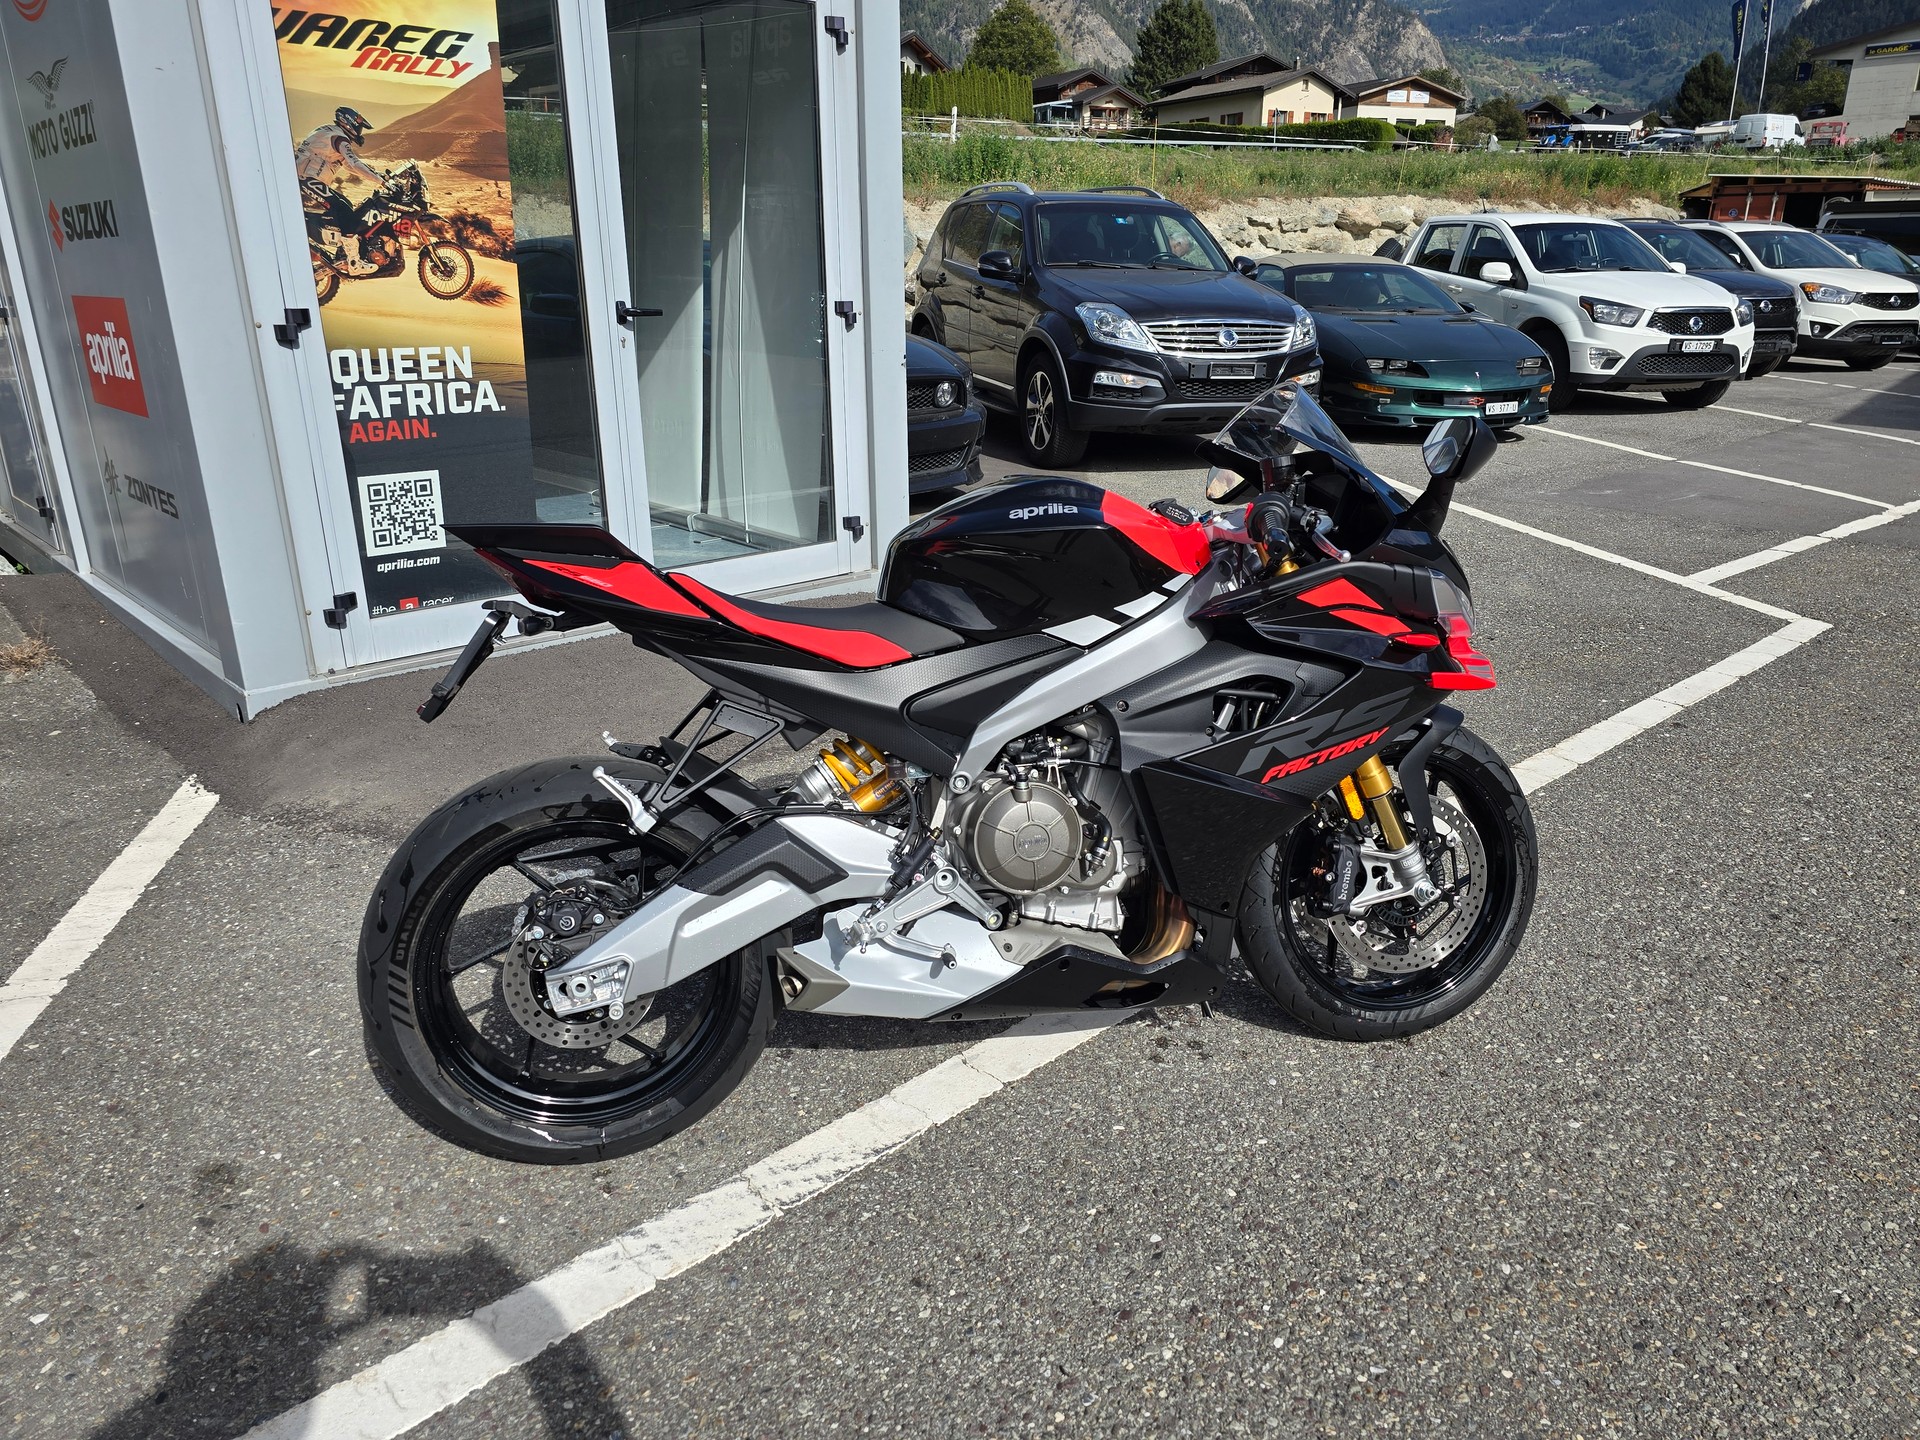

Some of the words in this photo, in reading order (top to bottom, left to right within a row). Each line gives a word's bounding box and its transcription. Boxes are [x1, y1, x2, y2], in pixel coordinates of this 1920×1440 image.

[350, 46, 473, 79] RALLY
[1876, 44, 1909, 54] GARAGE
[28, 118, 59, 160] MOTO
[58, 102, 97, 150] GUZZI
[62, 199, 119, 243] SUZUKI
[86, 321, 135, 385] aprilia
[330, 346, 473, 390] QUEEN
[350, 380, 506, 421] AFRICA.
[349, 417, 437, 444] AGAIN.
[124, 474, 180, 520] ZONTES
[1009, 503, 1078, 520] aprilia
[377, 556, 440, 573] aprilia.com
[1235, 686, 1415, 776] RS
[1261, 726, 1390, 784] FACTORY
[1338, 860, 1353, 900] brembo
